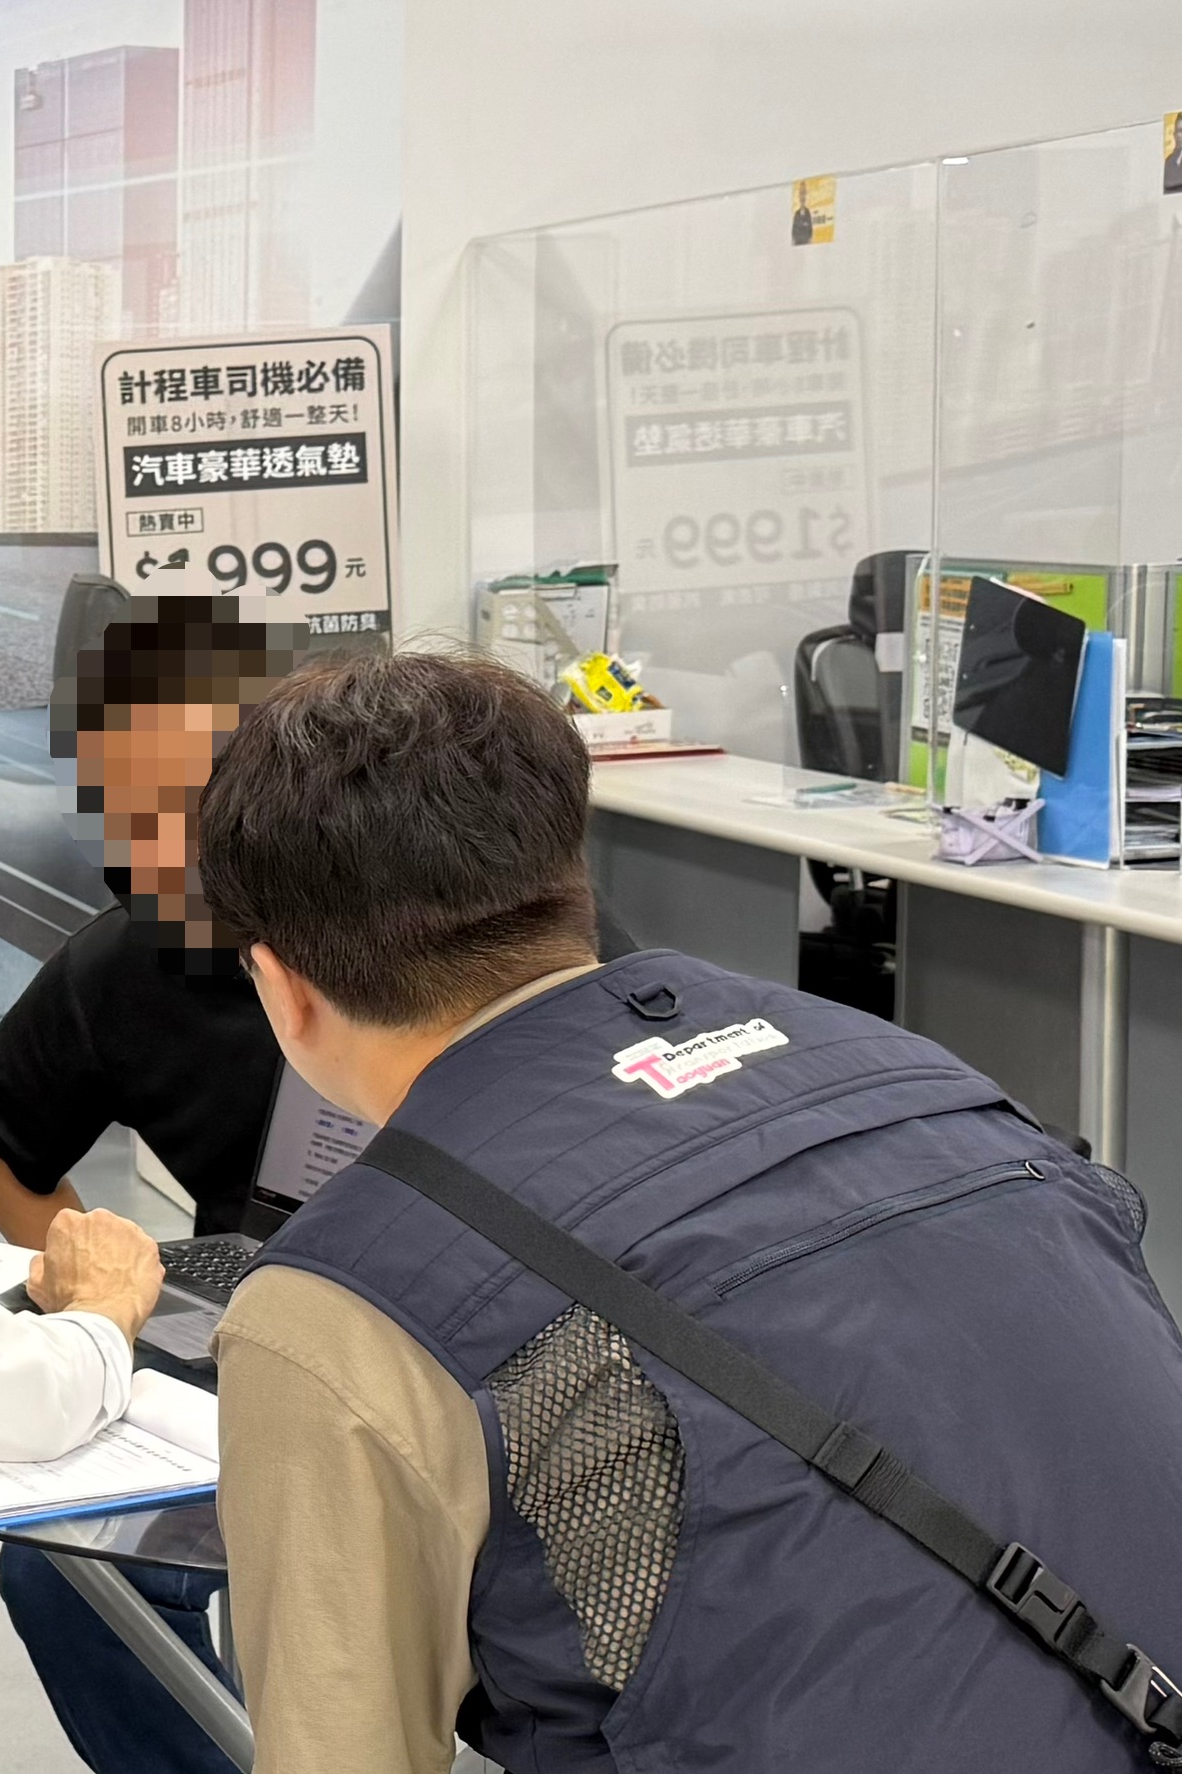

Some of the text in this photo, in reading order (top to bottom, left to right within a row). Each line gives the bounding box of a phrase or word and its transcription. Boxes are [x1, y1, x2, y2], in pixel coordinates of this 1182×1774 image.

[117, 356, 366, 405] 計程車司機必備
[130, 441, 360, 487] 汽車豪華透氣墊
[135, 539, 337, 596] 999
[663, 1027, 749, 1062] Department
